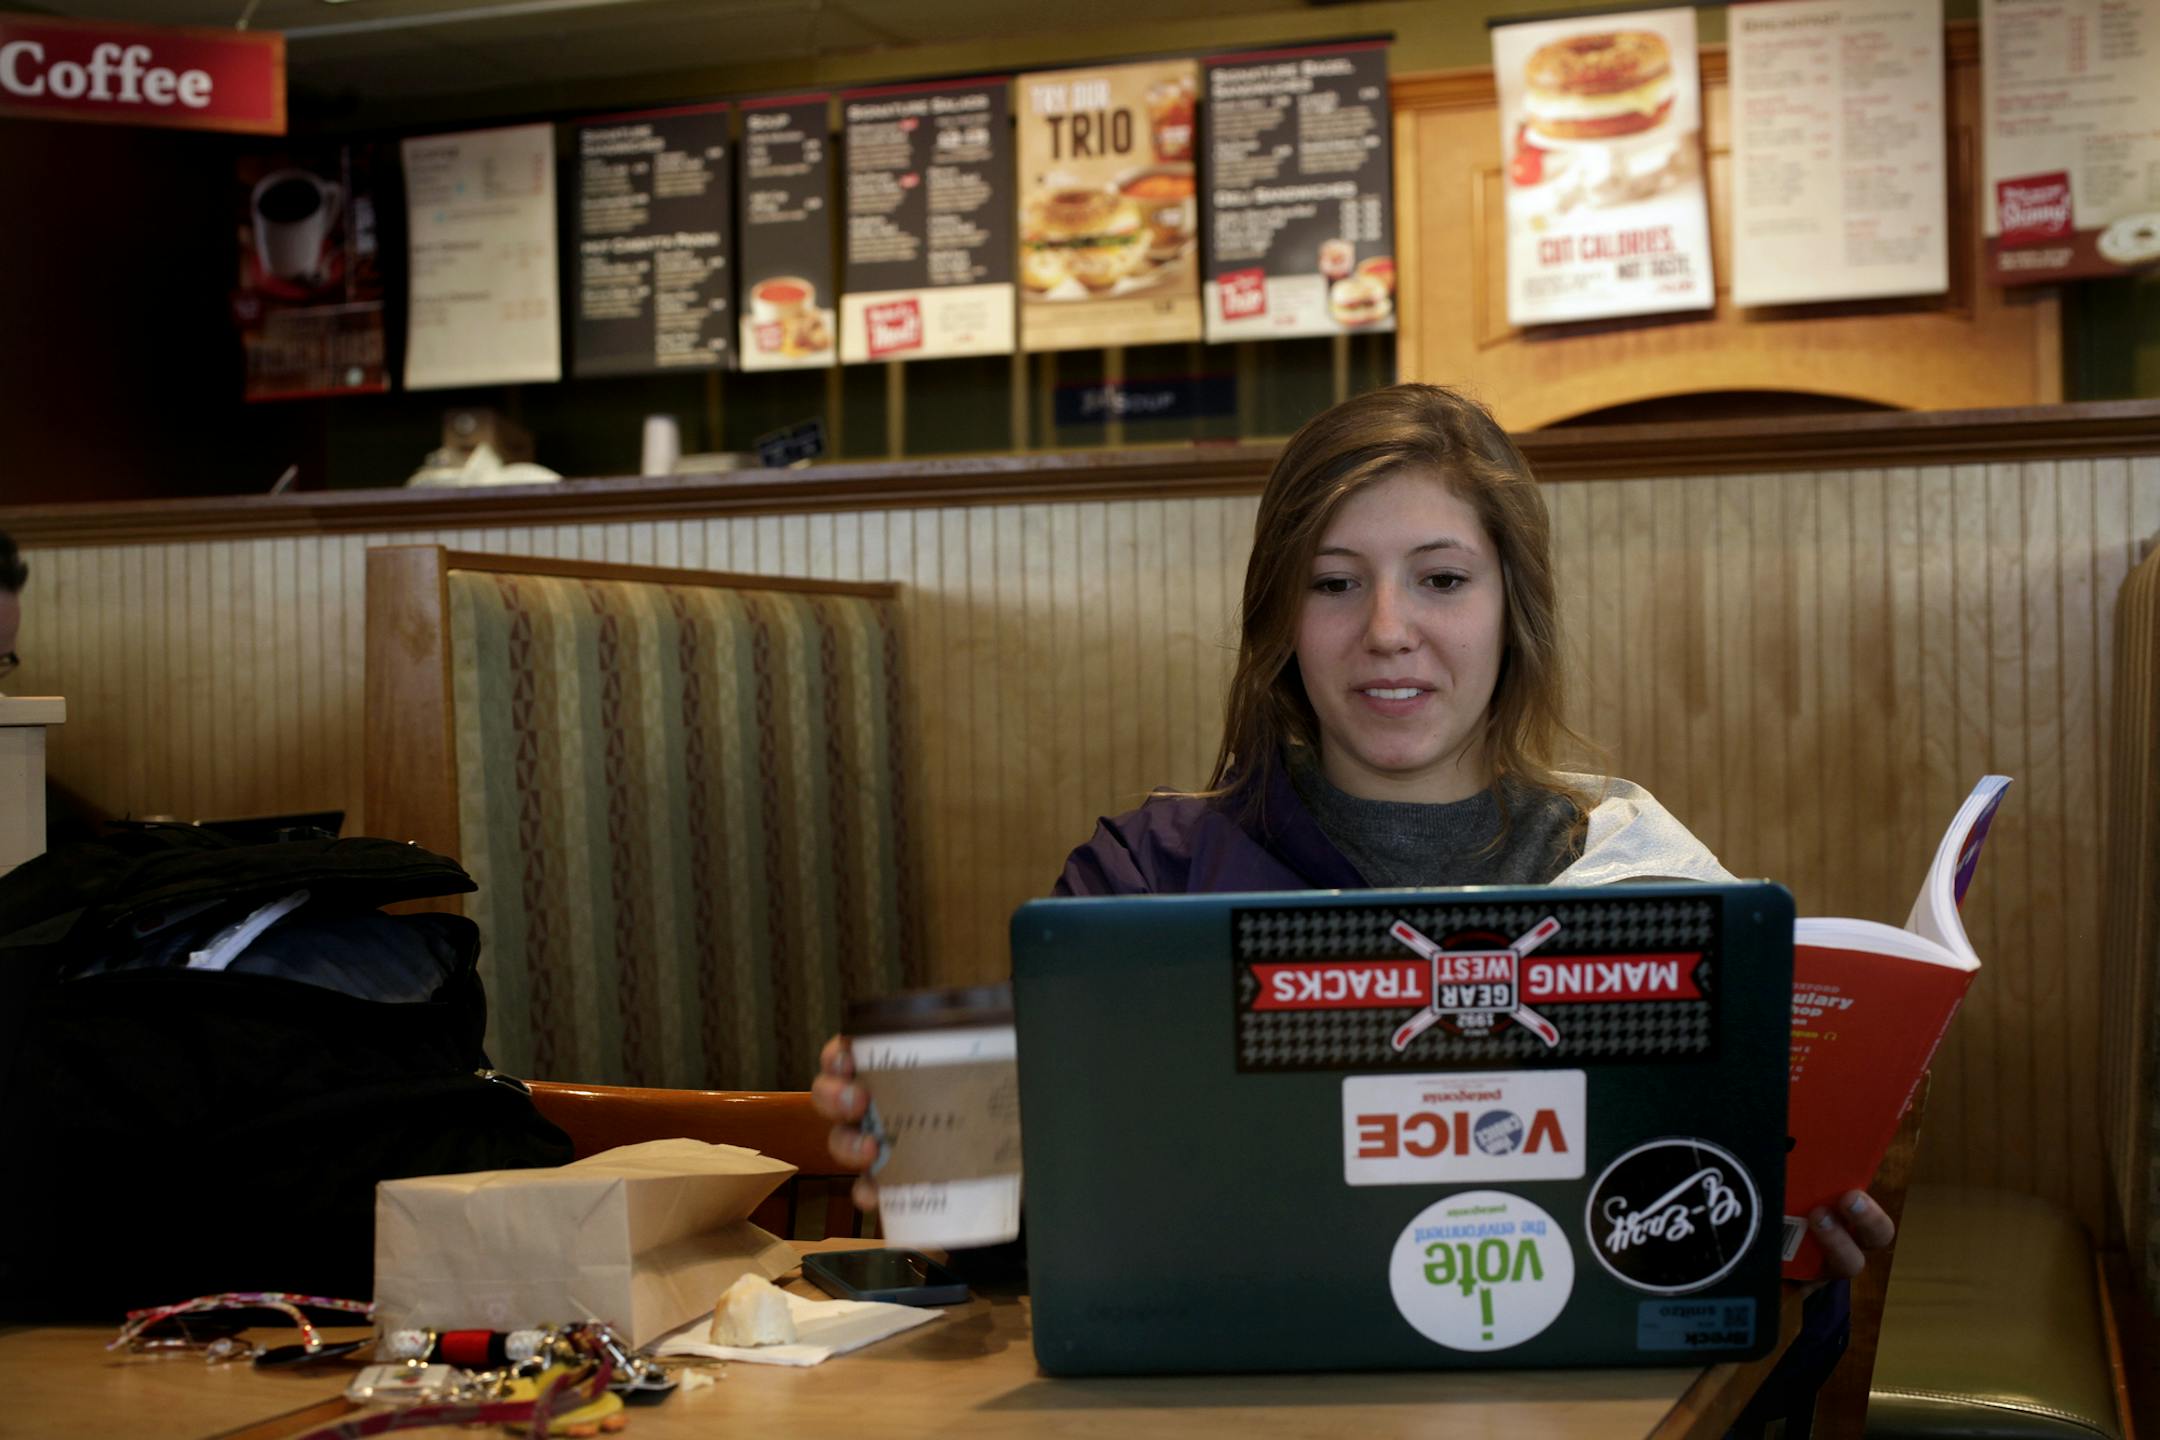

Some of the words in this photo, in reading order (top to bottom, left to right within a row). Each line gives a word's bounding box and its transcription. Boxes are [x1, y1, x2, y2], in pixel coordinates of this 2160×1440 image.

[0, 41, 213, 107] Coffee
[1046, 108, 1133, 161] TRIO
[1538, 235, 1573, 266] CUT
[1272, 966, 1422, 1002] TRACKS
[1440, 957, 1511, 982] WEST
[1529, 961, 1680, 995] MAKING
[1441, 984, 1510, 1007] GEAR
[1414, 1221, 1516, 1244] environment
[1521, 1219, 1547, 1236] the
[1423, 1237, 1544, 1298] vote
[1481, 1288, 1494, 1341] i
